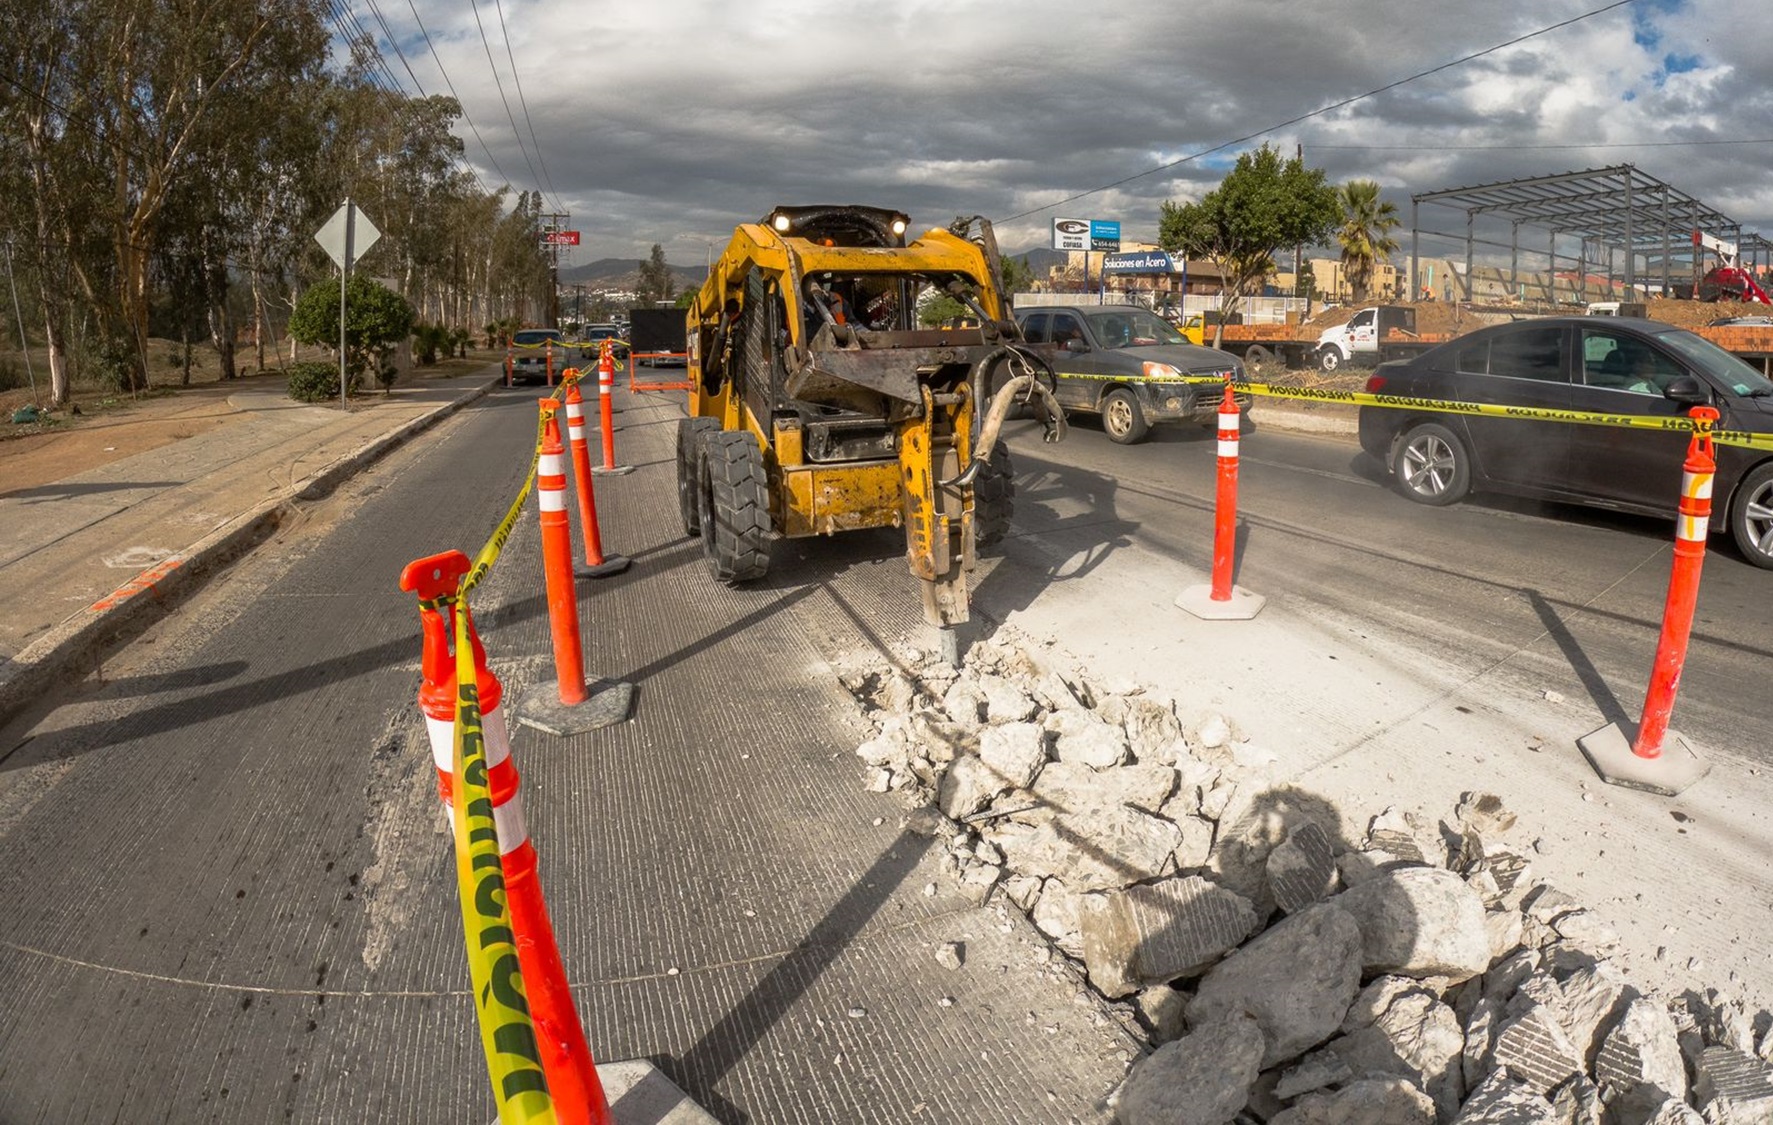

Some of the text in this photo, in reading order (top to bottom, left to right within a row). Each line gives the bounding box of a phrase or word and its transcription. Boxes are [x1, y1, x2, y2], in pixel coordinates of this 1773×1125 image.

[1104, 255, 1166, 269] Soluciones en Acero
